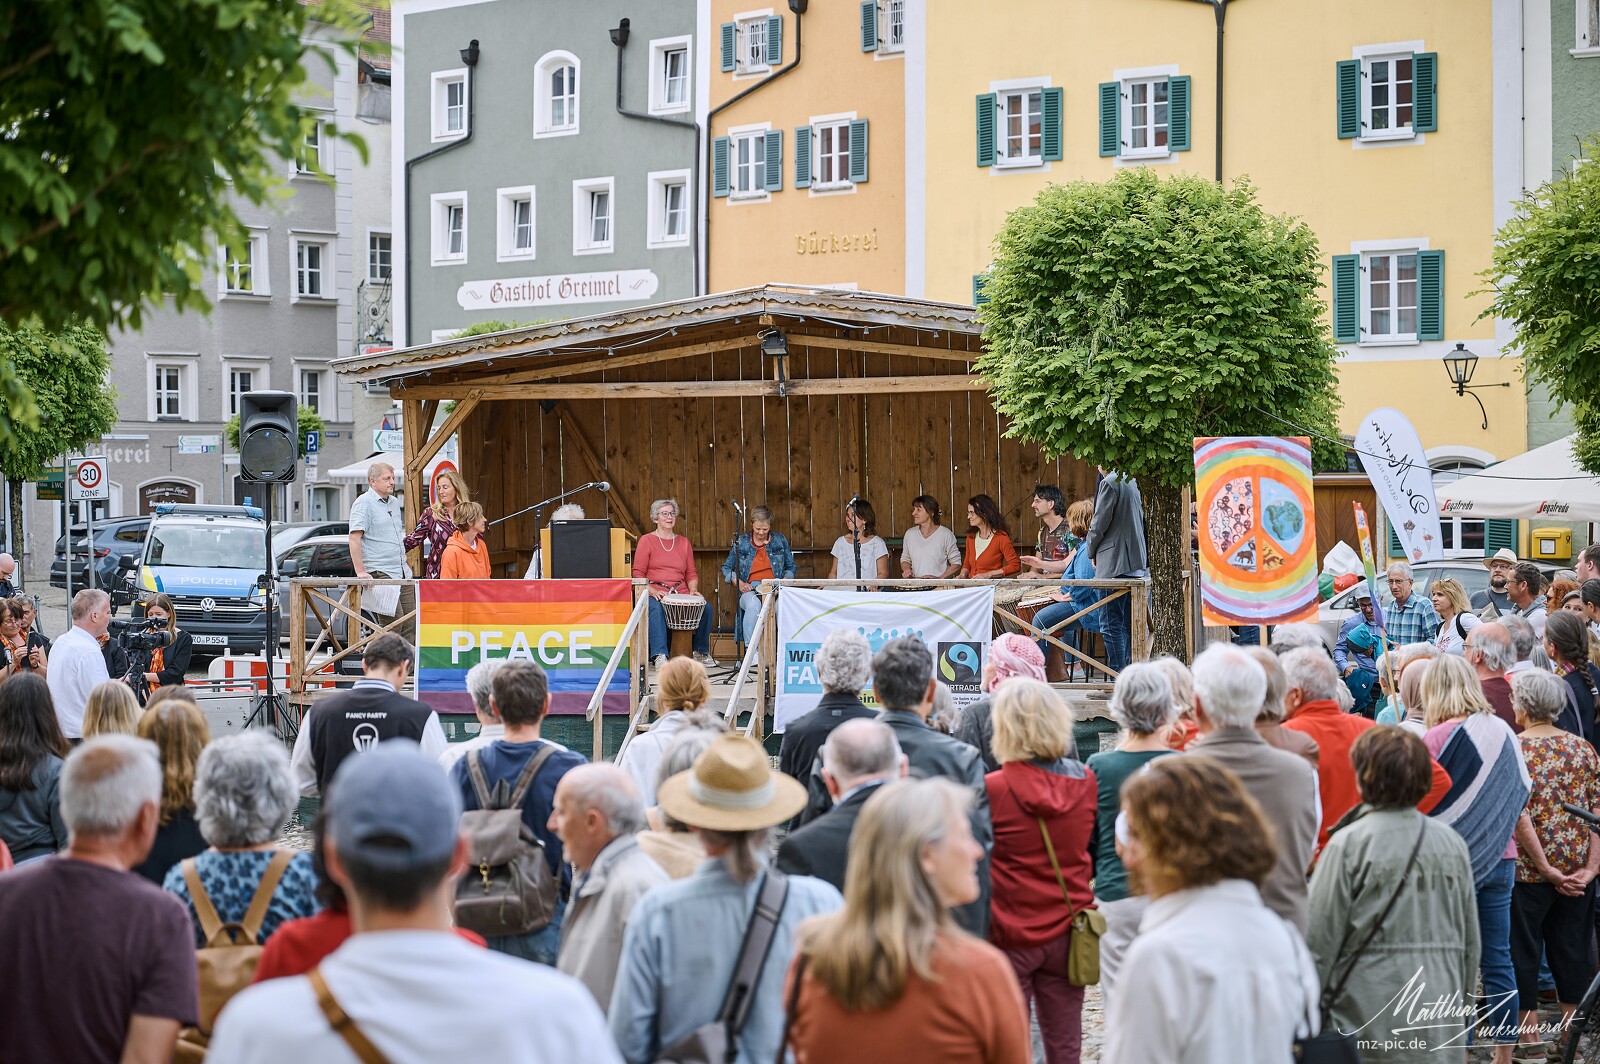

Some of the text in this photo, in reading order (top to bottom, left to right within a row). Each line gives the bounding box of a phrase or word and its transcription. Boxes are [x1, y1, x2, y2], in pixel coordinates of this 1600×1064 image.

[490, 274, 621, 303] Gasthof Greimel
[82, 469, 97, 481] 30
[1441, 499, 1474, 511] Segafredo
[1536, 500, 1570, 514] Segafredo
[180, 577, 237, 586] POLIZEI
[451, 631, 594, 665] PEACE
[345, 711, 388, 719] FANCY PARTY
